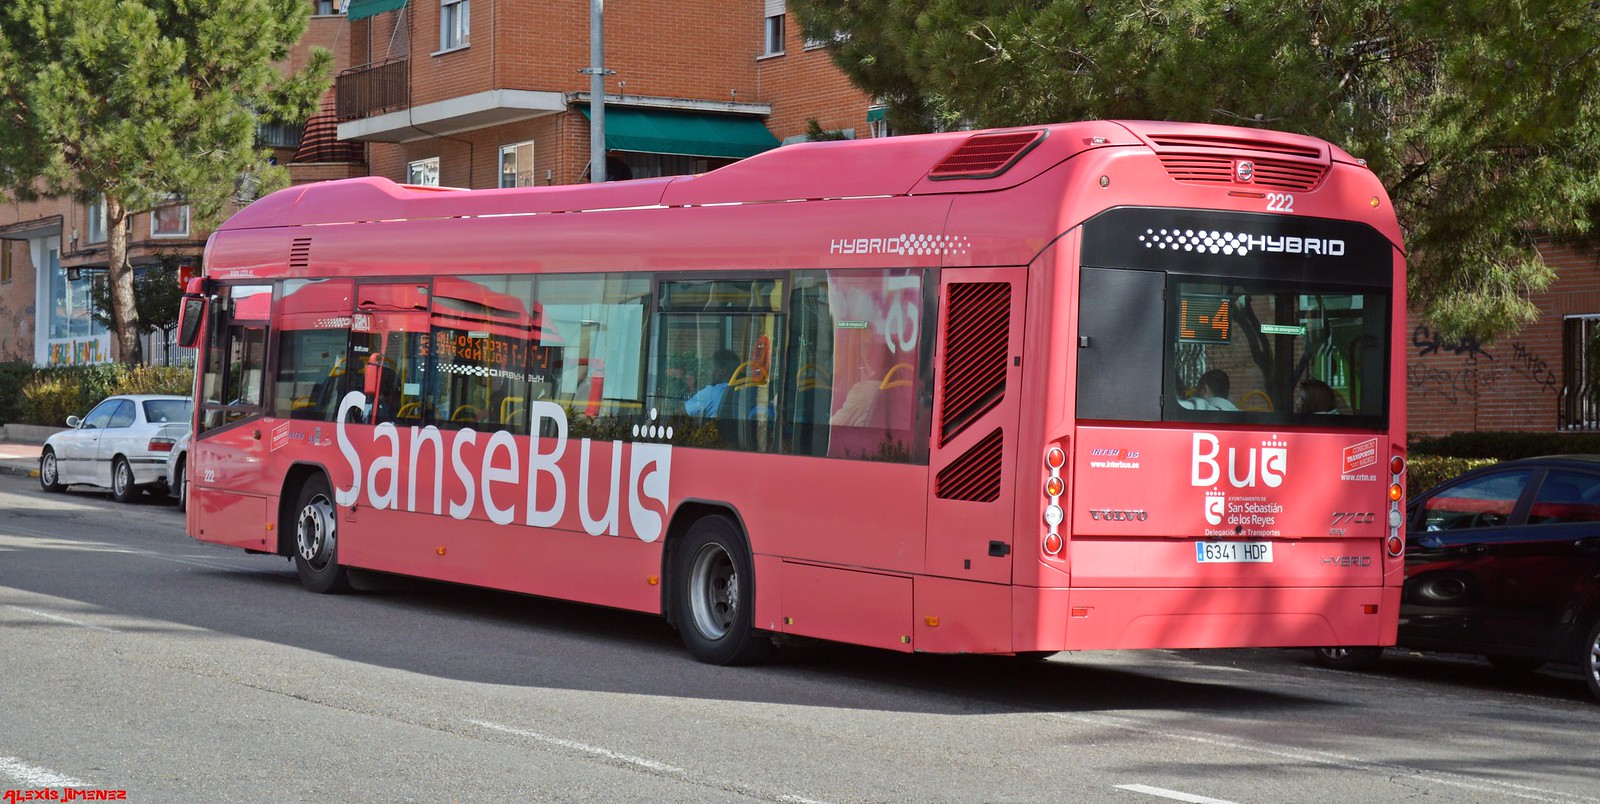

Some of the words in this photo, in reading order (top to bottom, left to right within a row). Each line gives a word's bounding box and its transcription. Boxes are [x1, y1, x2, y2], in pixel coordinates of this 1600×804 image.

[1266, 193, 1294, 212] 222
[830, 238, 900, 254] HYBRID
[1247, 234, 1345, 256] HYBRID
[1180, 299, 1230, 340] L-4
[335, 391, 673, 543] SanseBus
[1090, 461, 1140, 469] www.interbus.es
[1191, 432, 1287, 488] Bus
[204, 469, 215, 483] 222
[1341, 474, 1377, 482] www.crtm.es
[1089, 508, 1149, 521] VOLVO
[1228, 503, 1243, 513] San
[1244, 502, 1283, 513] Sebastián
[1228, 514, 1238, 525] de
[1239, 514, 1251, 525] los
[1251, 515, 1275, 527] Reyes
[1331, 511, 1375, 525] 7700
[1205, 528, 1237, 537] Delegación
[1247, 529, 1280, 537] Transportes
[1205, 545, 1237, 560] 6341
[1244, 545, 1268, 560] HDP
[1321, 556, 1371, 567] HYBRID
